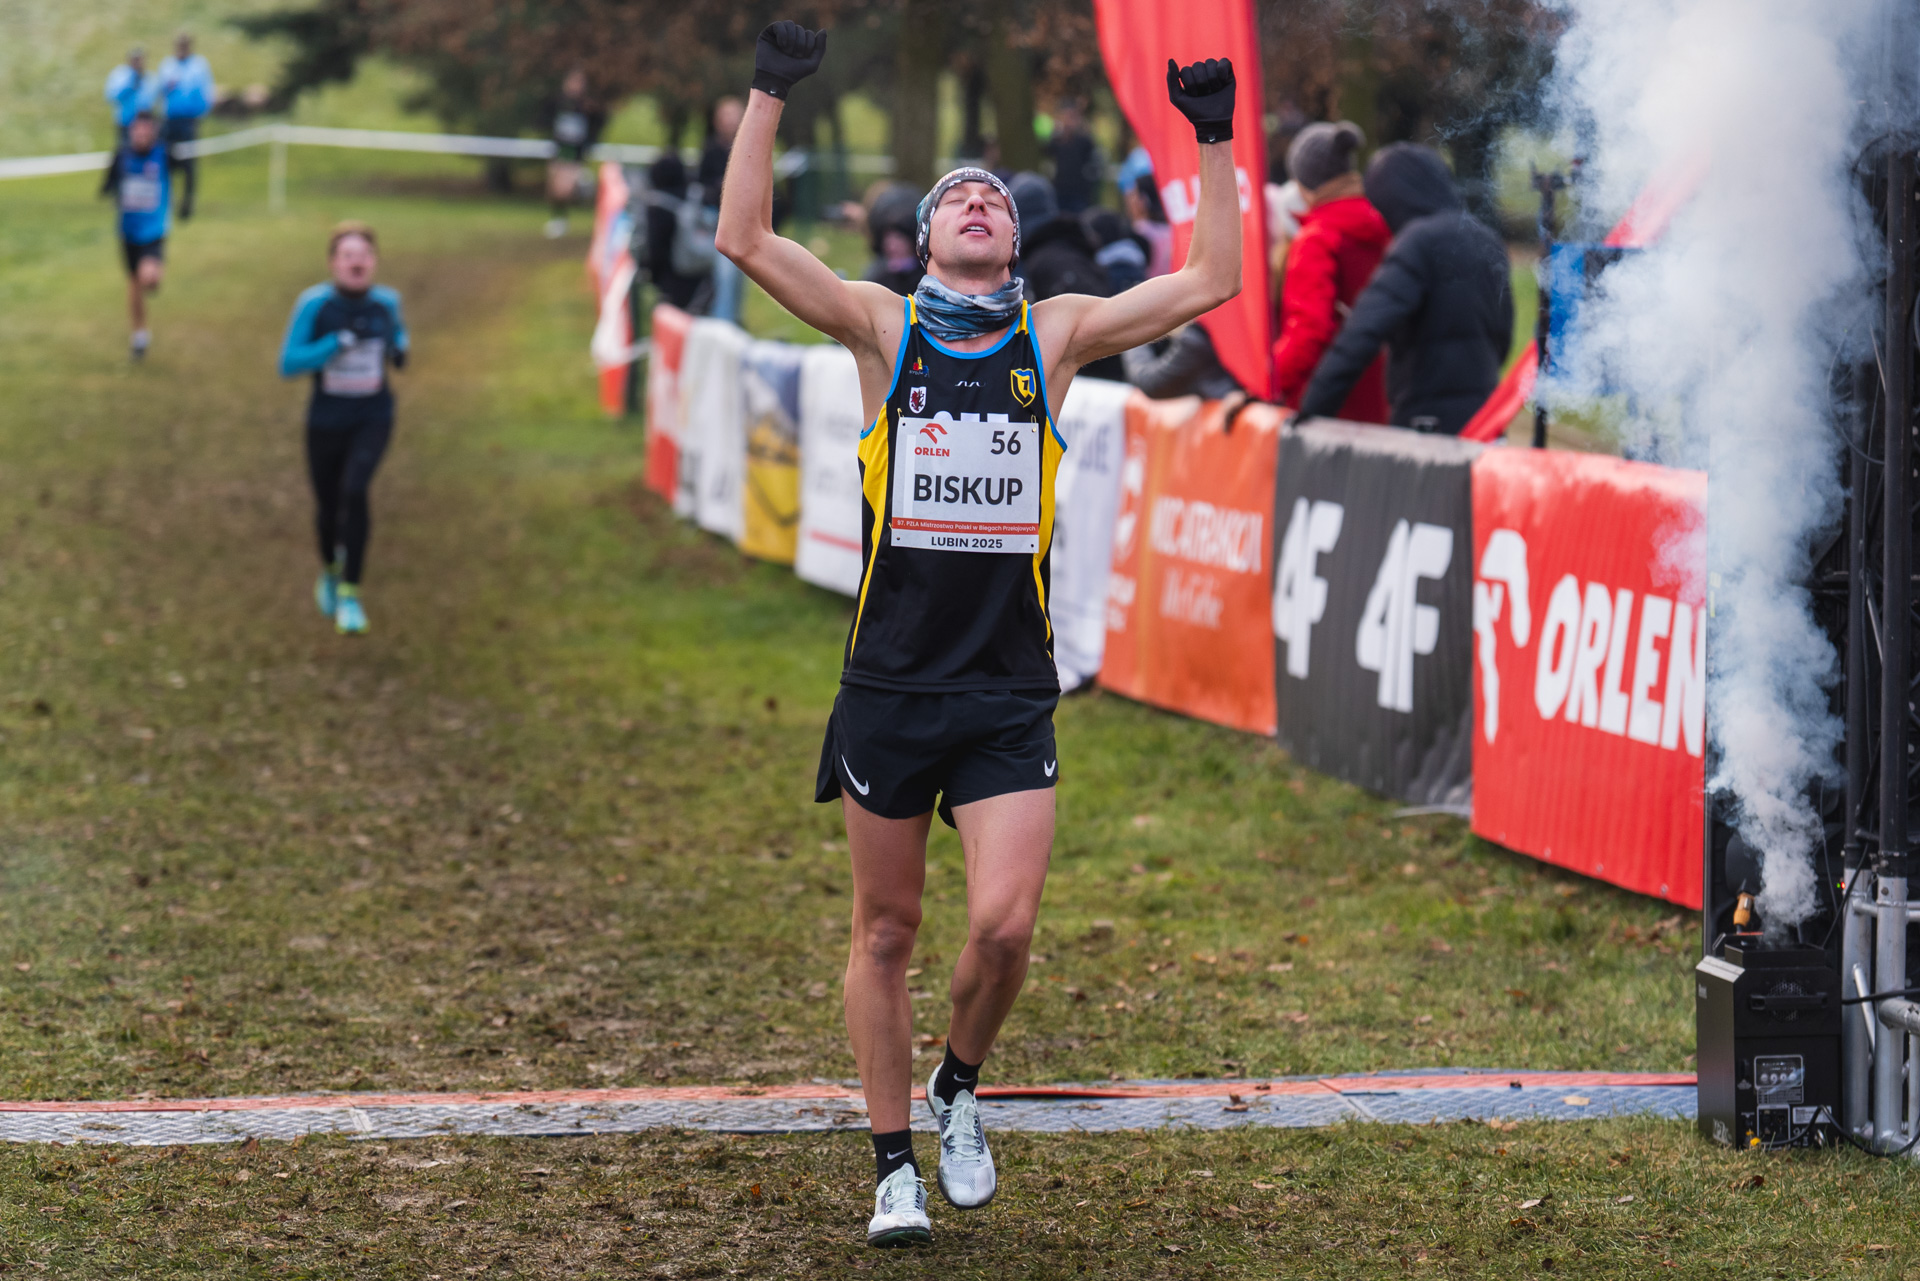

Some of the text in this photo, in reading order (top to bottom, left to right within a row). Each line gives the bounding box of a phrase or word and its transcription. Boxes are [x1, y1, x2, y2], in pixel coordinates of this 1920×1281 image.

[914, 446, 950, 457] ORLEN
[990, 430, 1022, 455] 56
[913, 473, 1023, 506] BISKUP
[920, 521, 954, 529] Mistrzostwa
[978, 524, 1002, 532] Biegach
[931, 536, 1003, 549] LUBIN 2025
[1273, 496, 1344, 680] 4F
[1356, 518, 1454, 713] 4F
[1535, 573, 1706, 758] ORLEN
